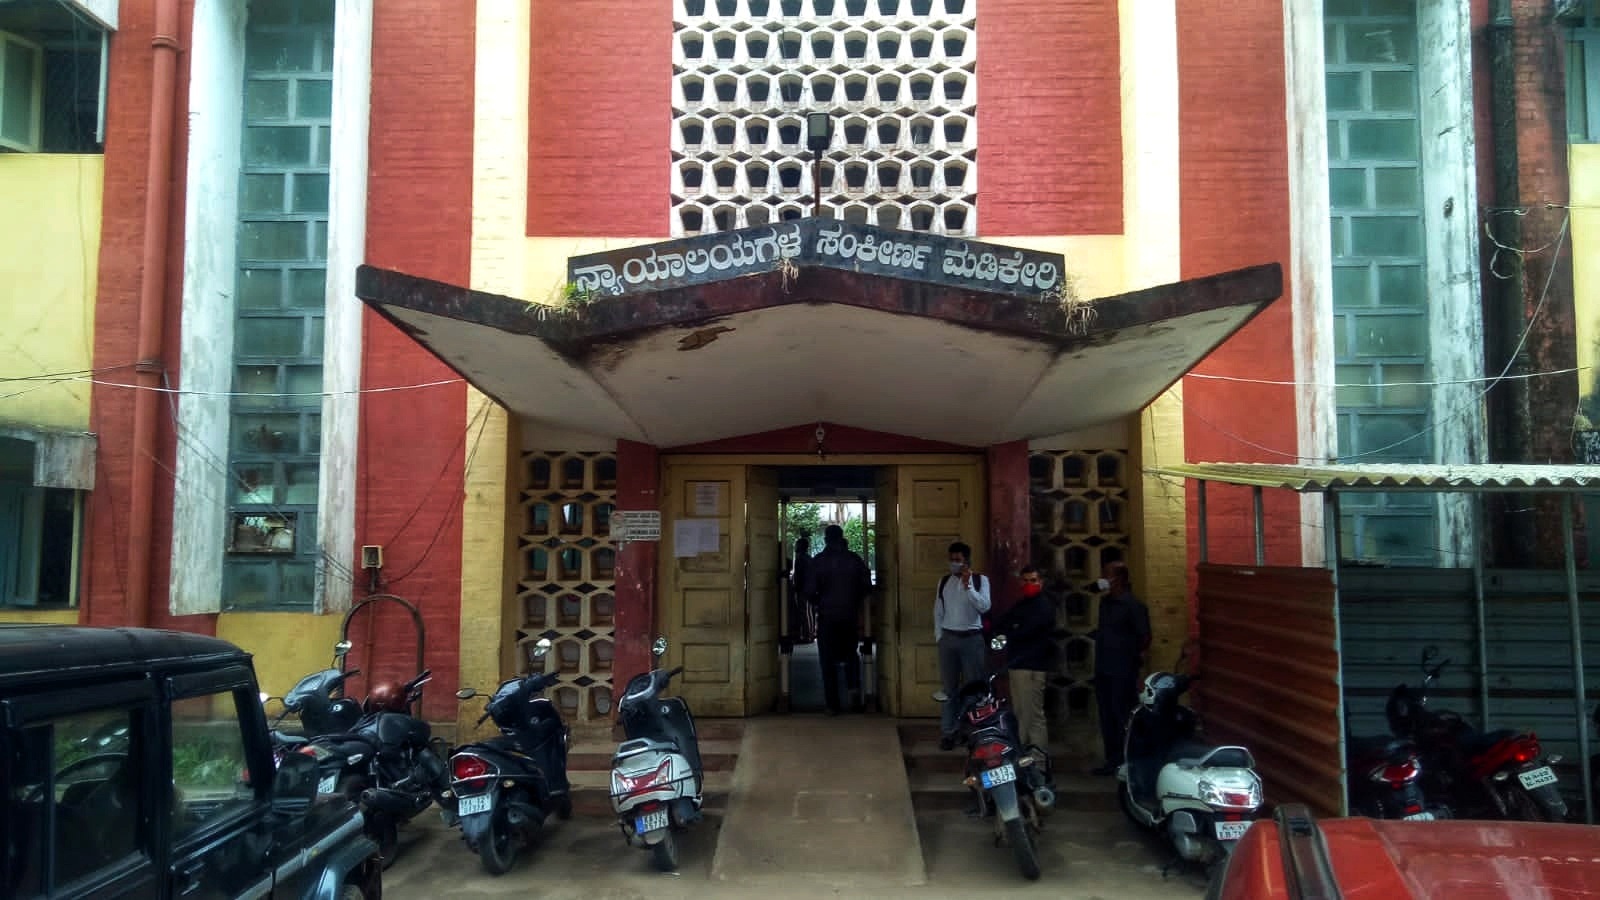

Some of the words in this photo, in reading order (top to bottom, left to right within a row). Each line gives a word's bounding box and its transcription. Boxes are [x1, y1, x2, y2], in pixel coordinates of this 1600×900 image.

[574, 223, 801, 295] ನ್ಯಾಯಾಲಯಗಳ
[816, 223, 932, 270] ಸಂಕೀರ್ಣ
[942, 242, 1057, 290] ಮಡಿಕೇರಿ
